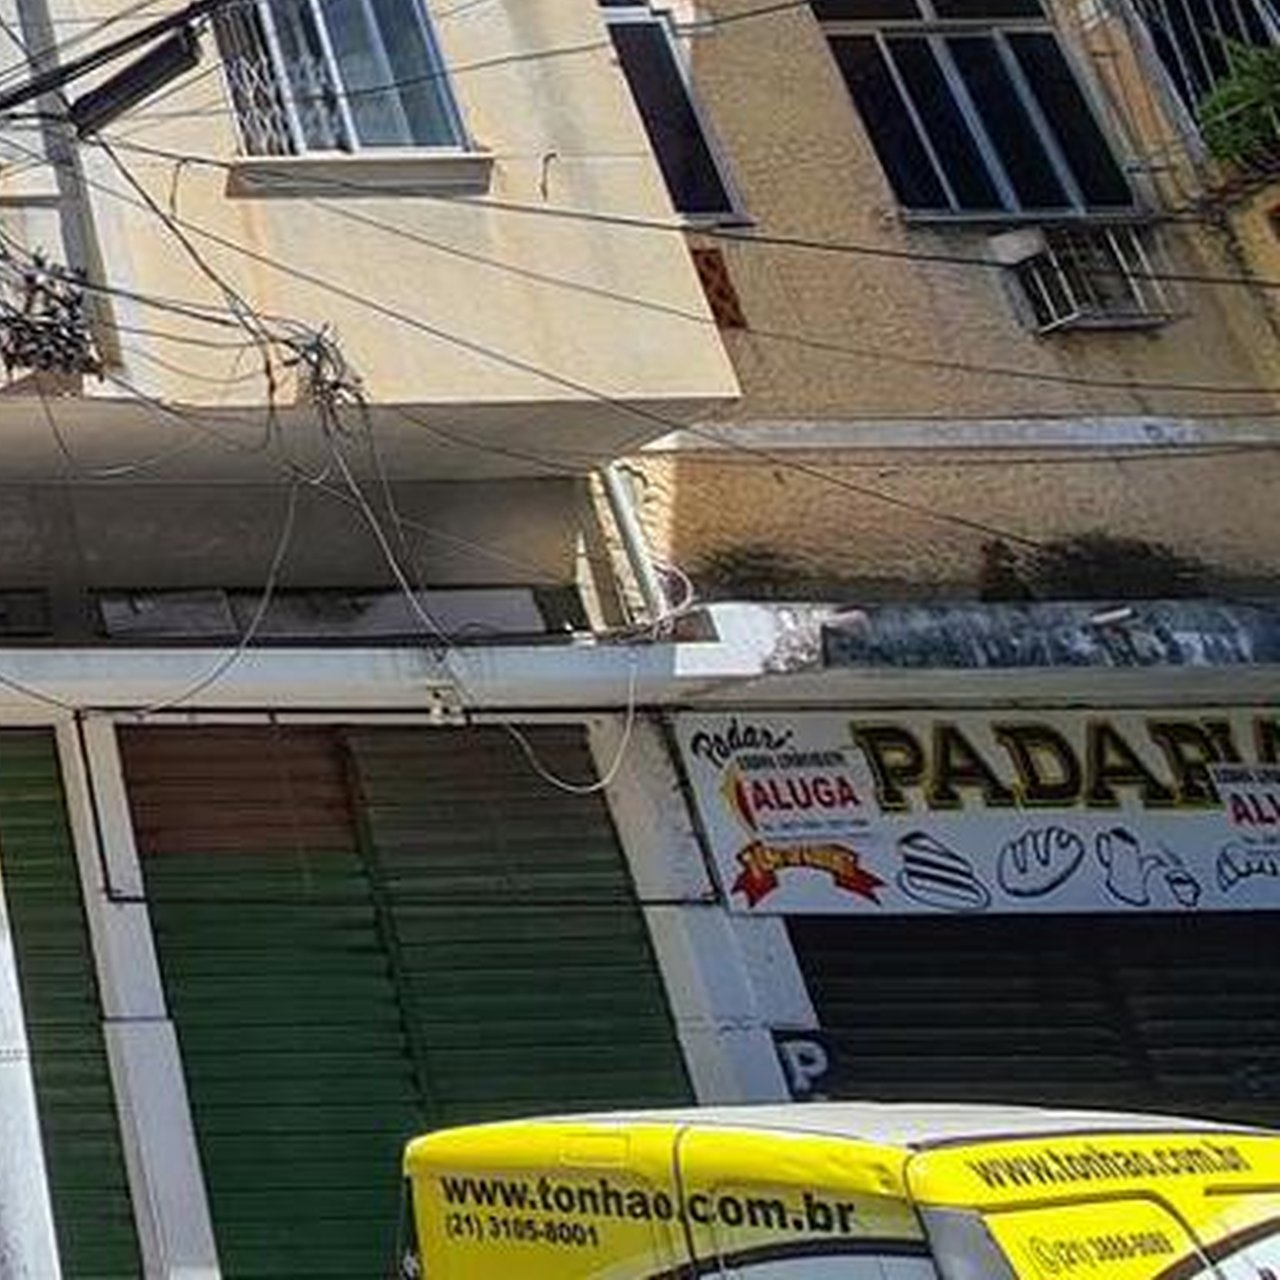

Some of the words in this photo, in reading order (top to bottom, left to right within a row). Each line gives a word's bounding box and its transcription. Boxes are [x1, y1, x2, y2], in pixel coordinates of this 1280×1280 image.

[751, 775, 861, 811] ALUGA
[1231, 792, 1280, 826] AL
[440, 1176, 856, 1234] www.tonhao.com.br
[445, 1212, 483, 1242] (21)
